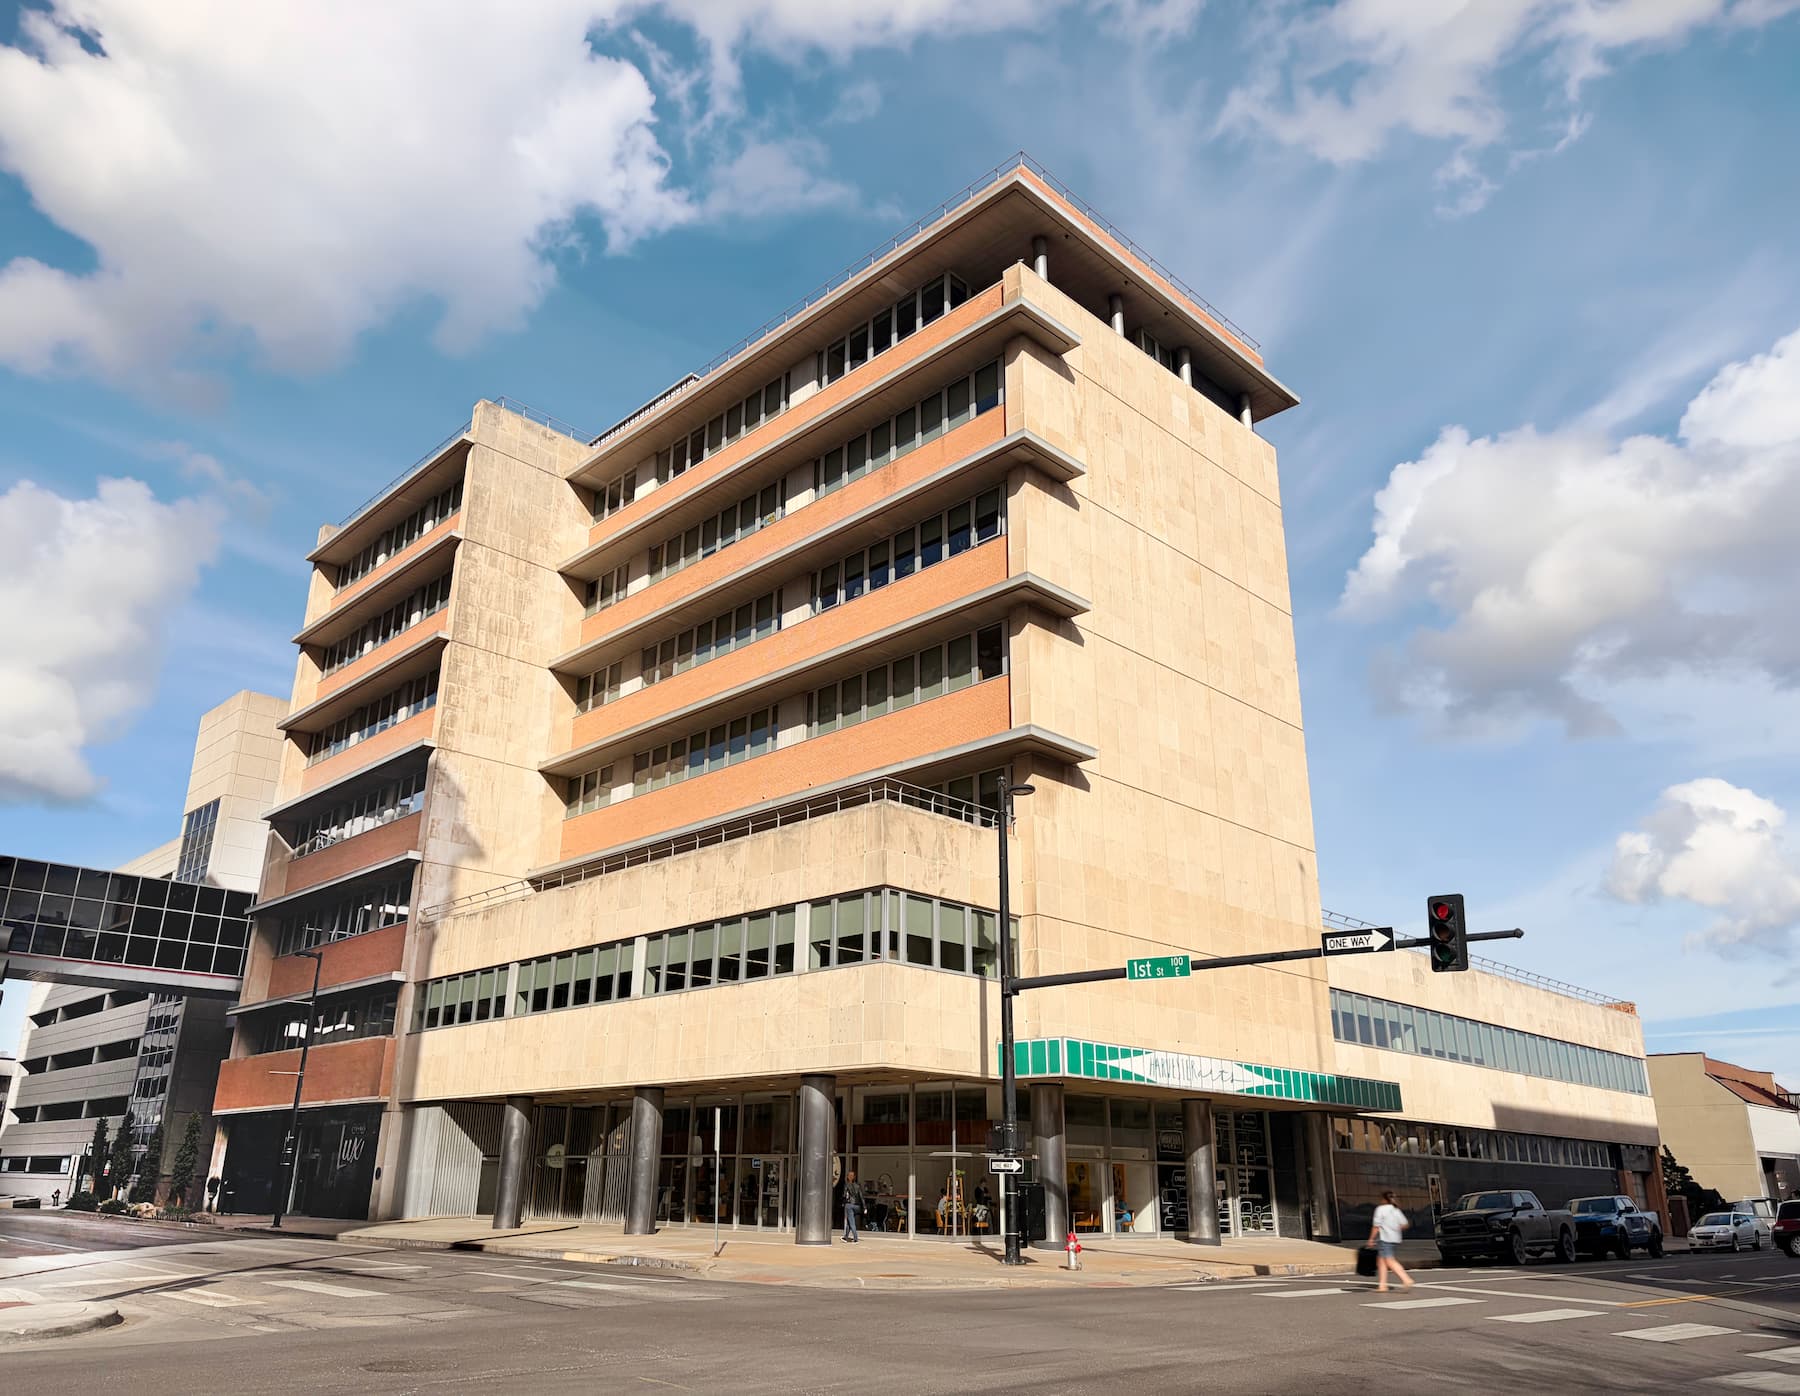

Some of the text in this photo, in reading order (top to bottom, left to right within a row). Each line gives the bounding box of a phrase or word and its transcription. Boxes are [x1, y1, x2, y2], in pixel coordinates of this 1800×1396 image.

[1329, 936, 1371, 949] ONE WAY
[1171, 957, 1183, 967] 100
[1133, 960, 1164, 978] 1st St
[1175, 967, 1180, 976] E
[337, 1124, 365, 1169] Lux
